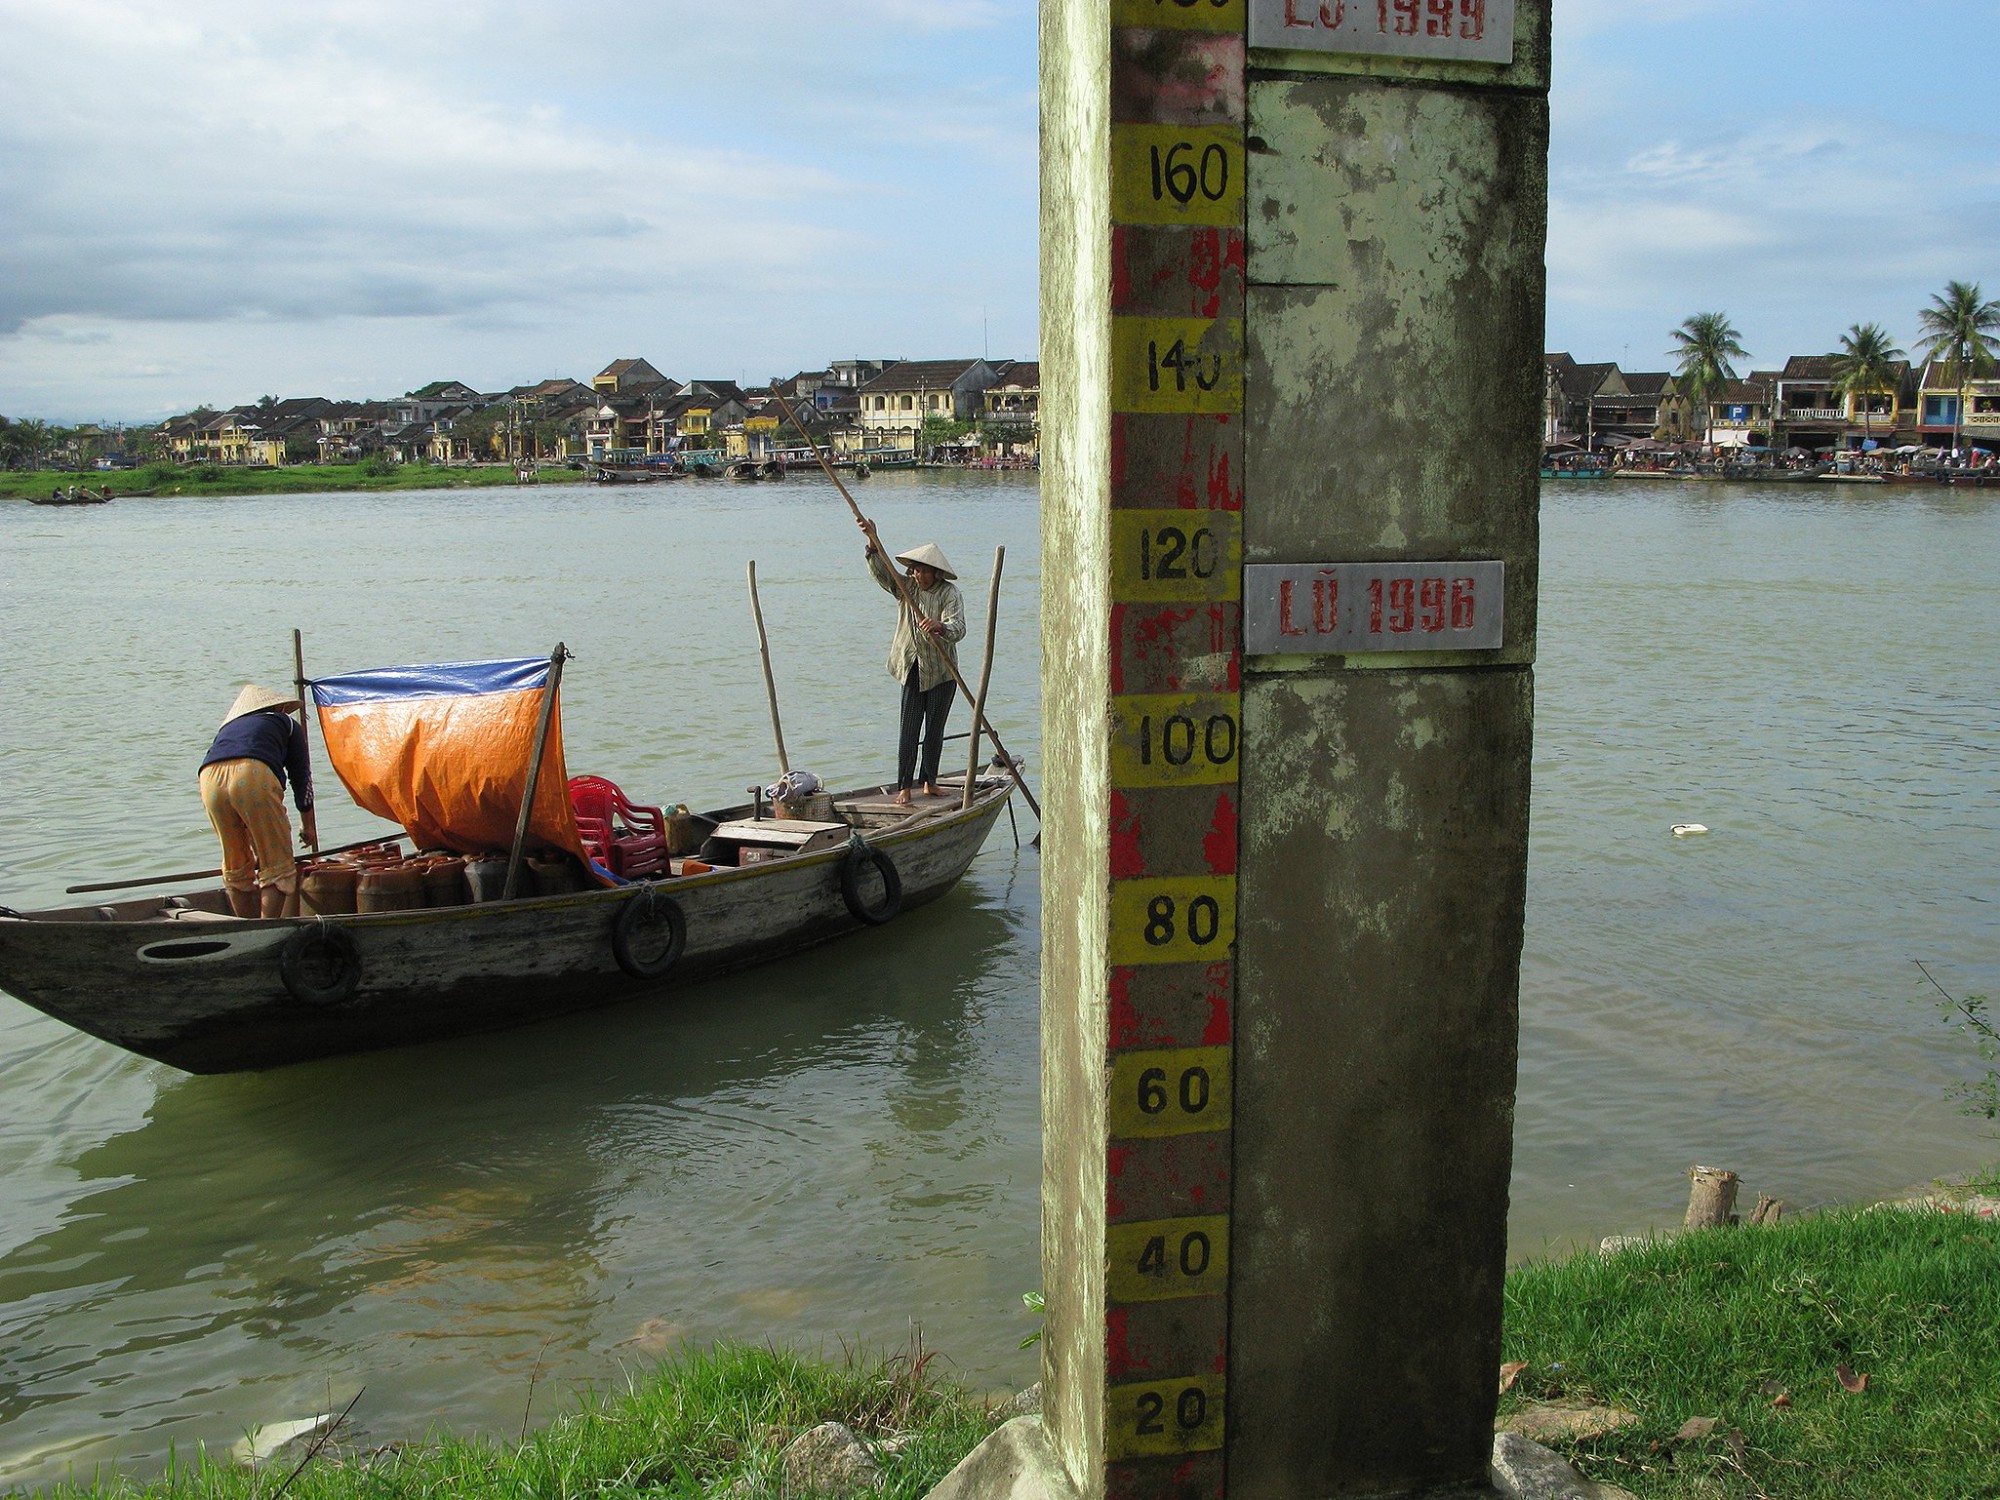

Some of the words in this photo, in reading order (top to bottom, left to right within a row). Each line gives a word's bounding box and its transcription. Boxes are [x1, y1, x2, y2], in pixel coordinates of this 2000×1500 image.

[1376, 0, 1485, 40] 1999
[1151, 142, 1227, 203] 160
[1148, 339, 1221, 392] 140
[1732, 407, 1743, 418] P
[1141, 526, 1218, 580] 120
[1367, 577, 1475, 634] 1996
[1141, 713, 1237, 765] 100
[1144, 894, 1219, 946] 80
[1137, 1066, 1210, 1115] 60
[1137, 1230, 1211, 1278] 40
[1135, 1387, 1206, 1436] 20
